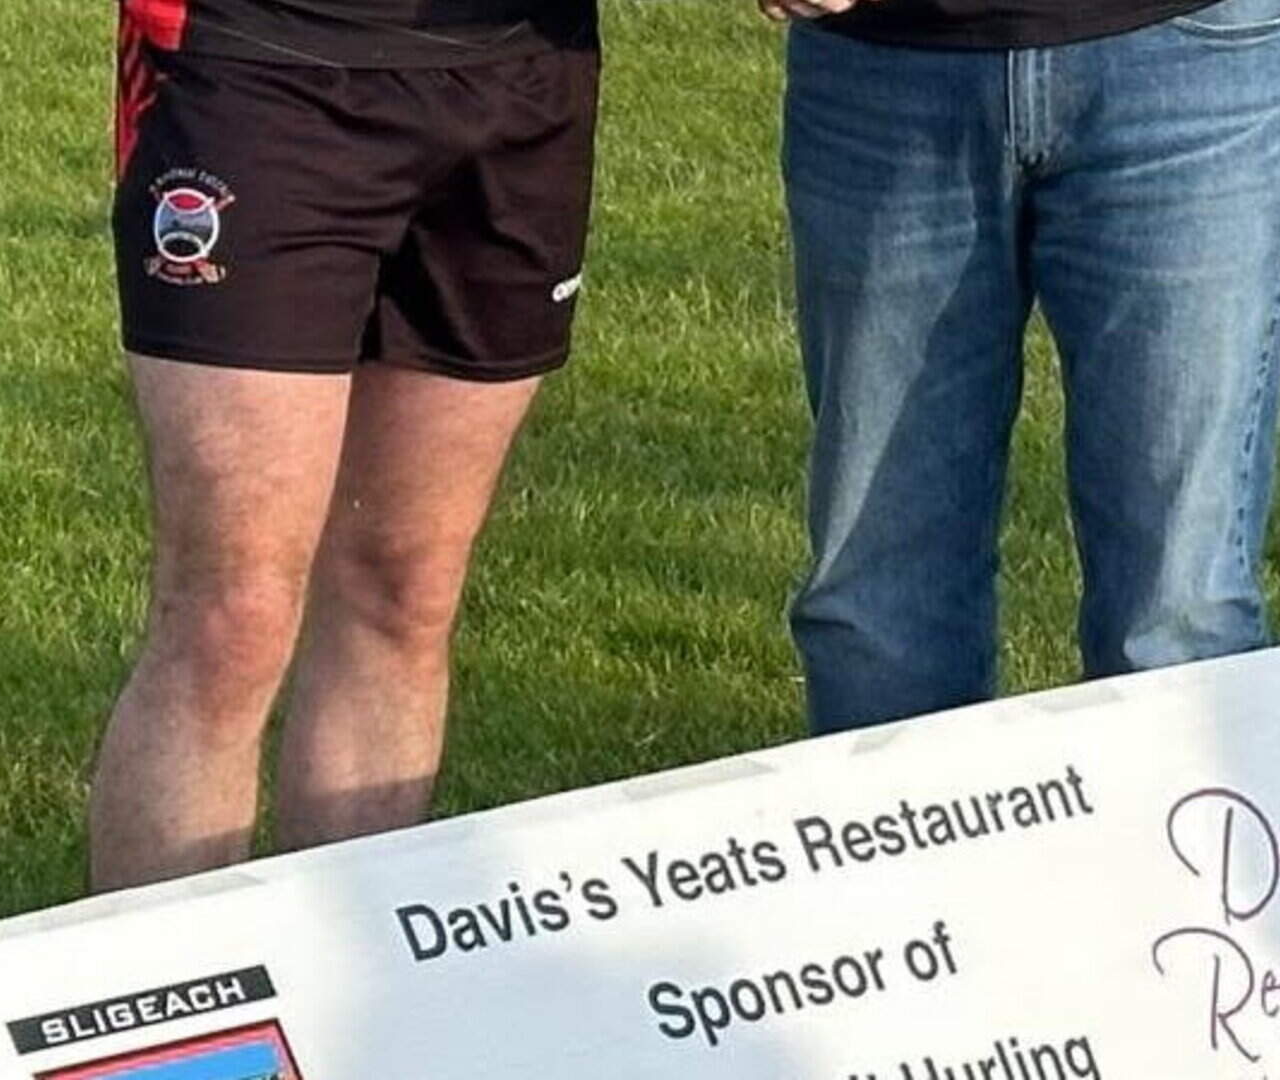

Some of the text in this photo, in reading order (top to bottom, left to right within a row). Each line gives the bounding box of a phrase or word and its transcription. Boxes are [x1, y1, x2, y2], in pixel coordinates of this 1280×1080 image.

[395, 766, 1094, 962] Davis's Yeats Restaurant
[40, 977, 247, 1045] SLIGEACH
[647, 921, 959, 1047] Sponsor of
[899, 1035, 1101, 1080] rling
